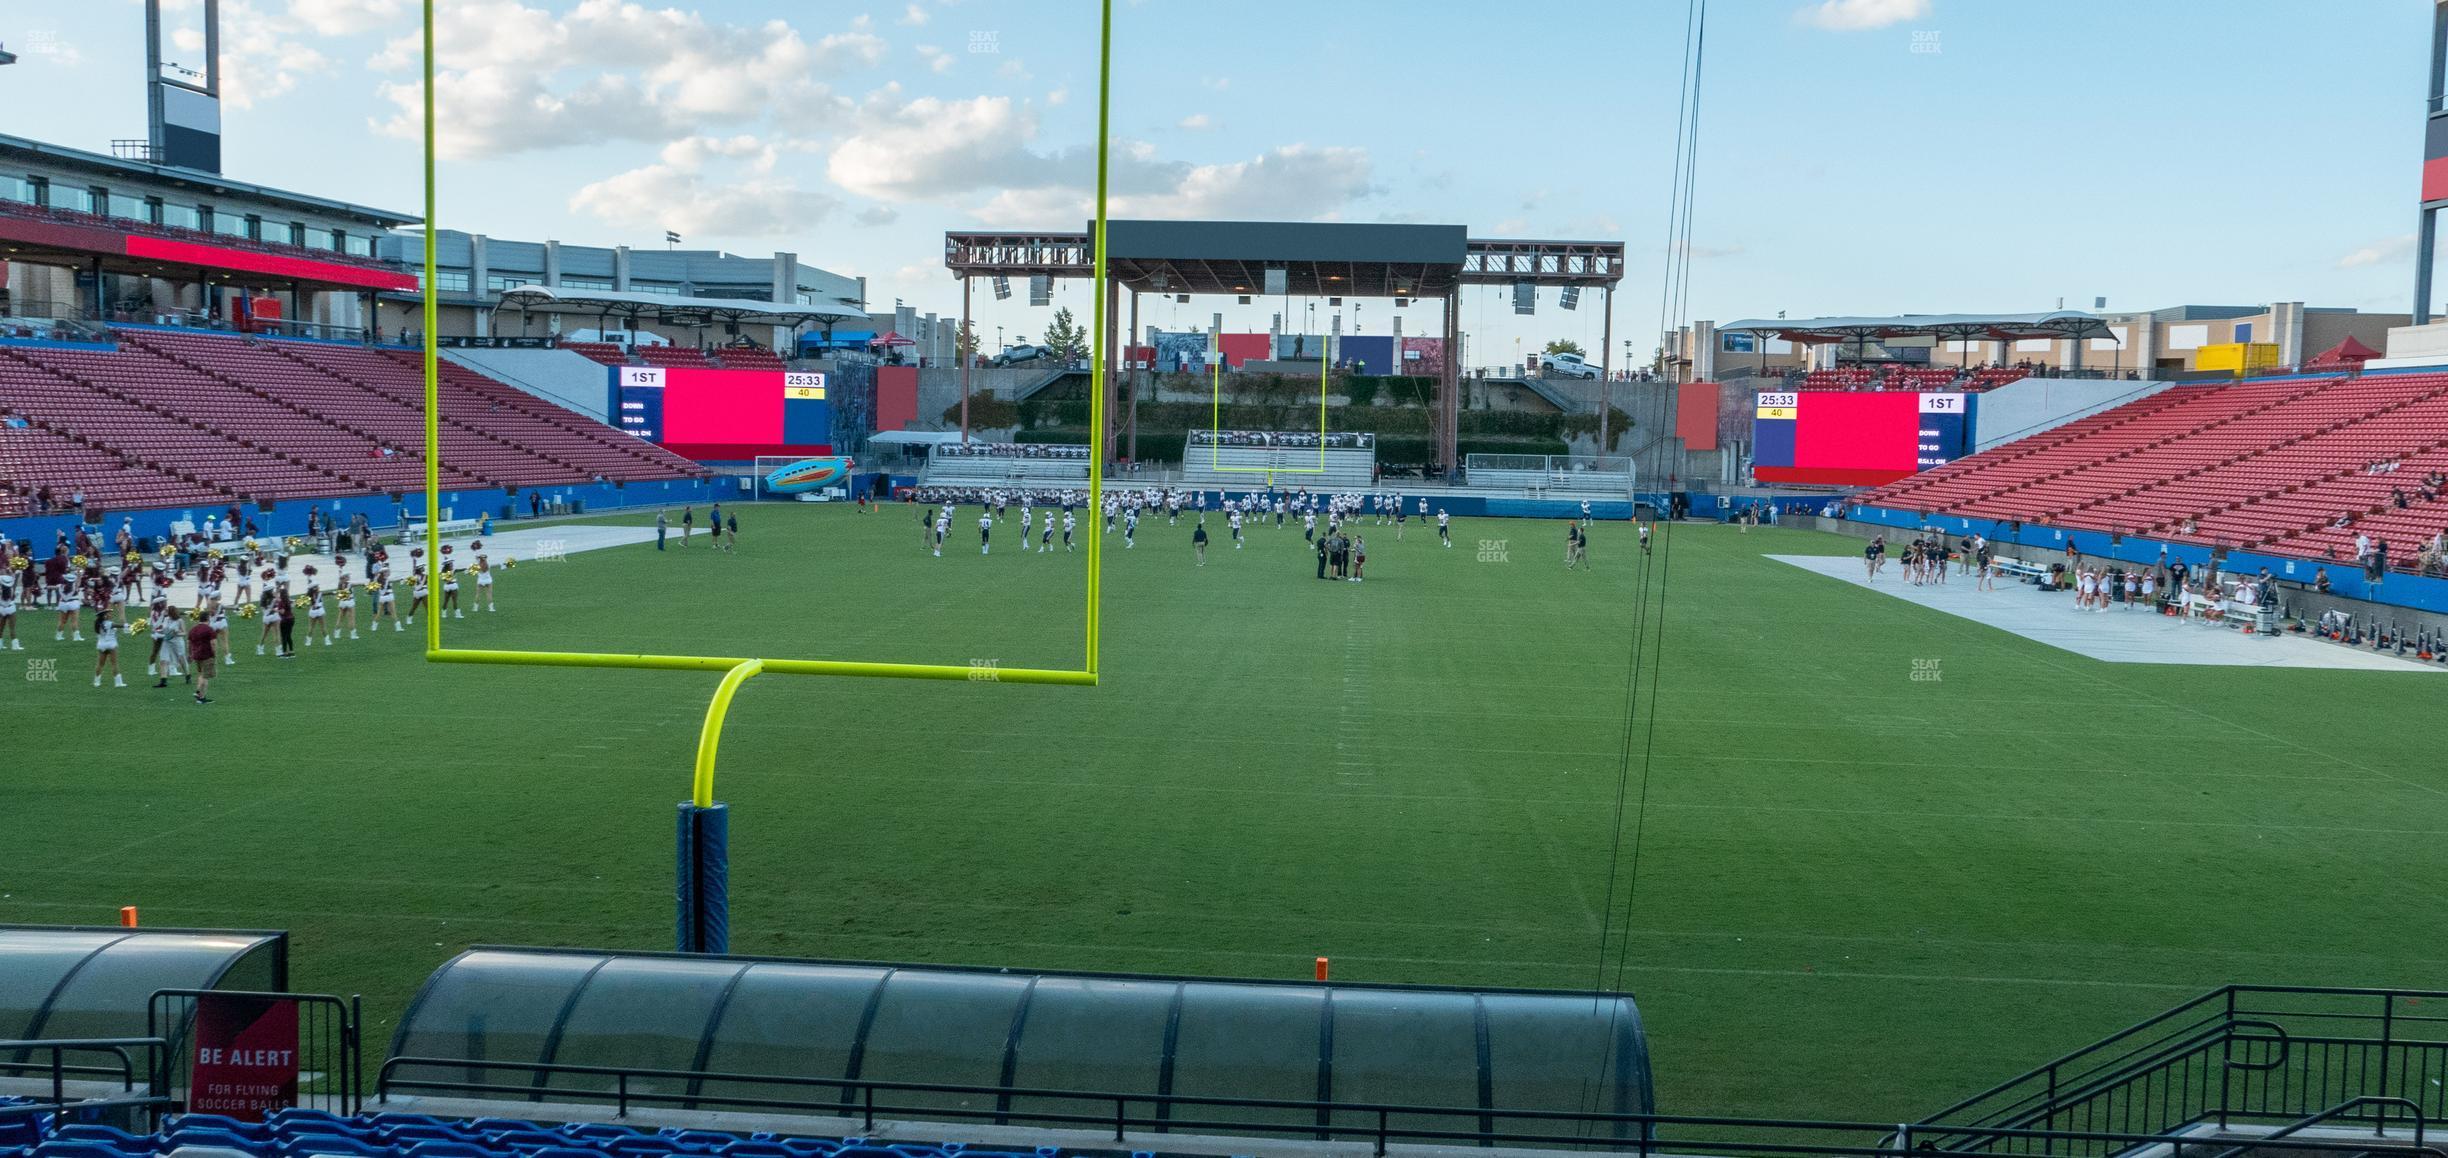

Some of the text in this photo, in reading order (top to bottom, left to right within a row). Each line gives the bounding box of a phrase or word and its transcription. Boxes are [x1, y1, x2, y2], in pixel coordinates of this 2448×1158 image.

[631, 373, 656, 383] 1ST
[787, 376, 820, 386] 25:33
[798, 389, 809, 397] 40
[1761, 395, 1794, 405] 25:33
[1928, 398, 1954, 409] 1ST
[1771, 409, 1782, 417] 40
[200, 1047, 292, 1067] BE ALERT
[208, 1083, 279, 1096] FOR FLYING
[198, 1098, 289, 1111] SOCCER BALLS
